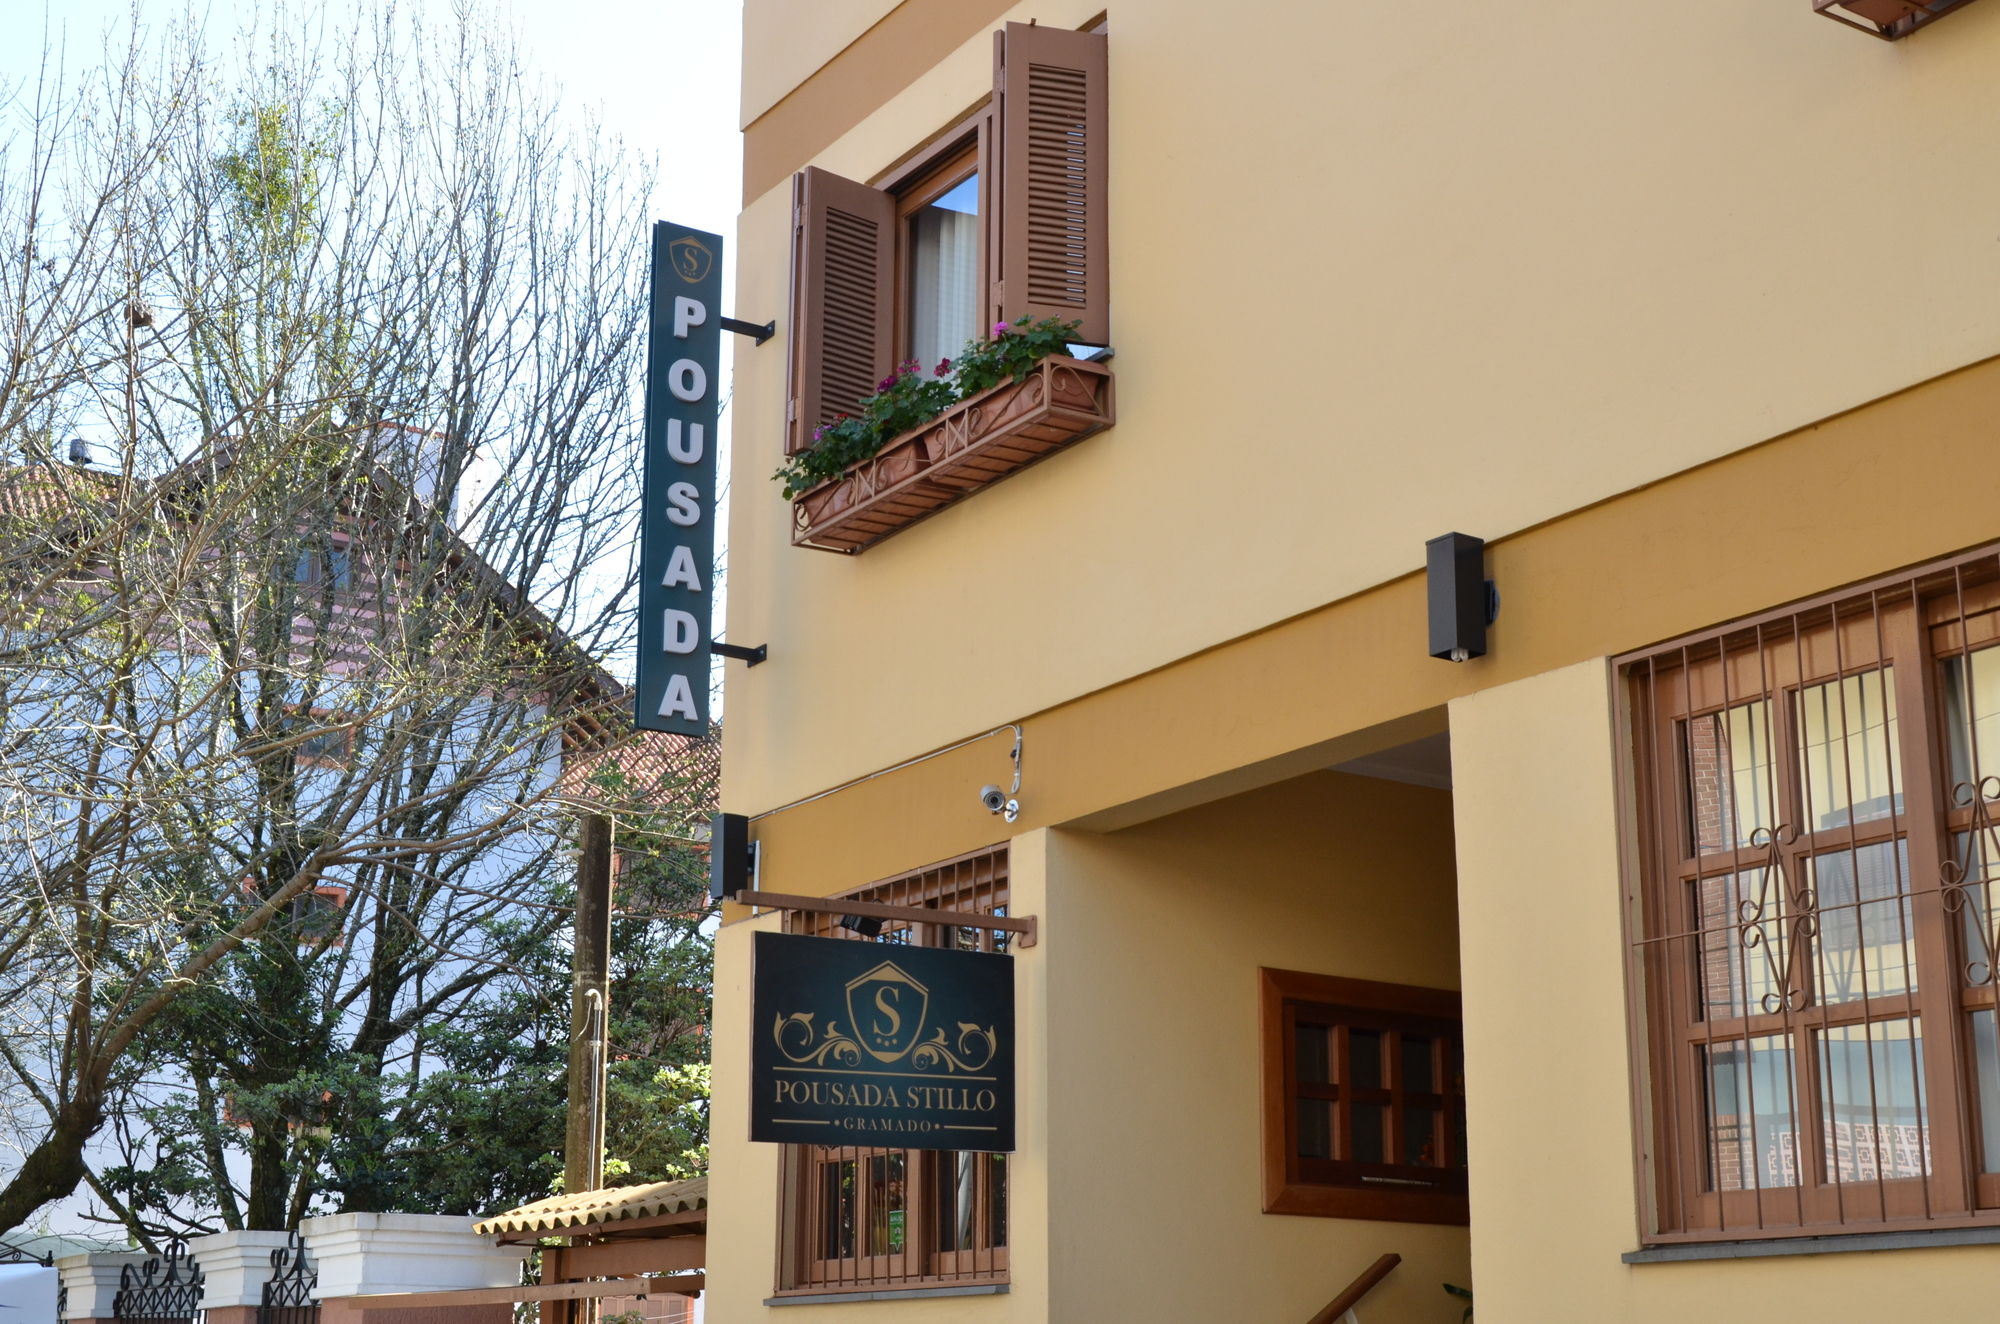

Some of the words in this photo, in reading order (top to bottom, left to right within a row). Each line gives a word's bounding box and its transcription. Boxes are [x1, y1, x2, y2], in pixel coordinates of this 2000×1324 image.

[683, 247, 698, 272] S
[657, 295, 707, 721] POUSADA
[873, 985, 901, 1037] S
[775, 1079, 900, 1108] POUSADA
[906, 1086, 996, 1112] STILLO
[843, 1116, 932, 1133] GRAMADO
